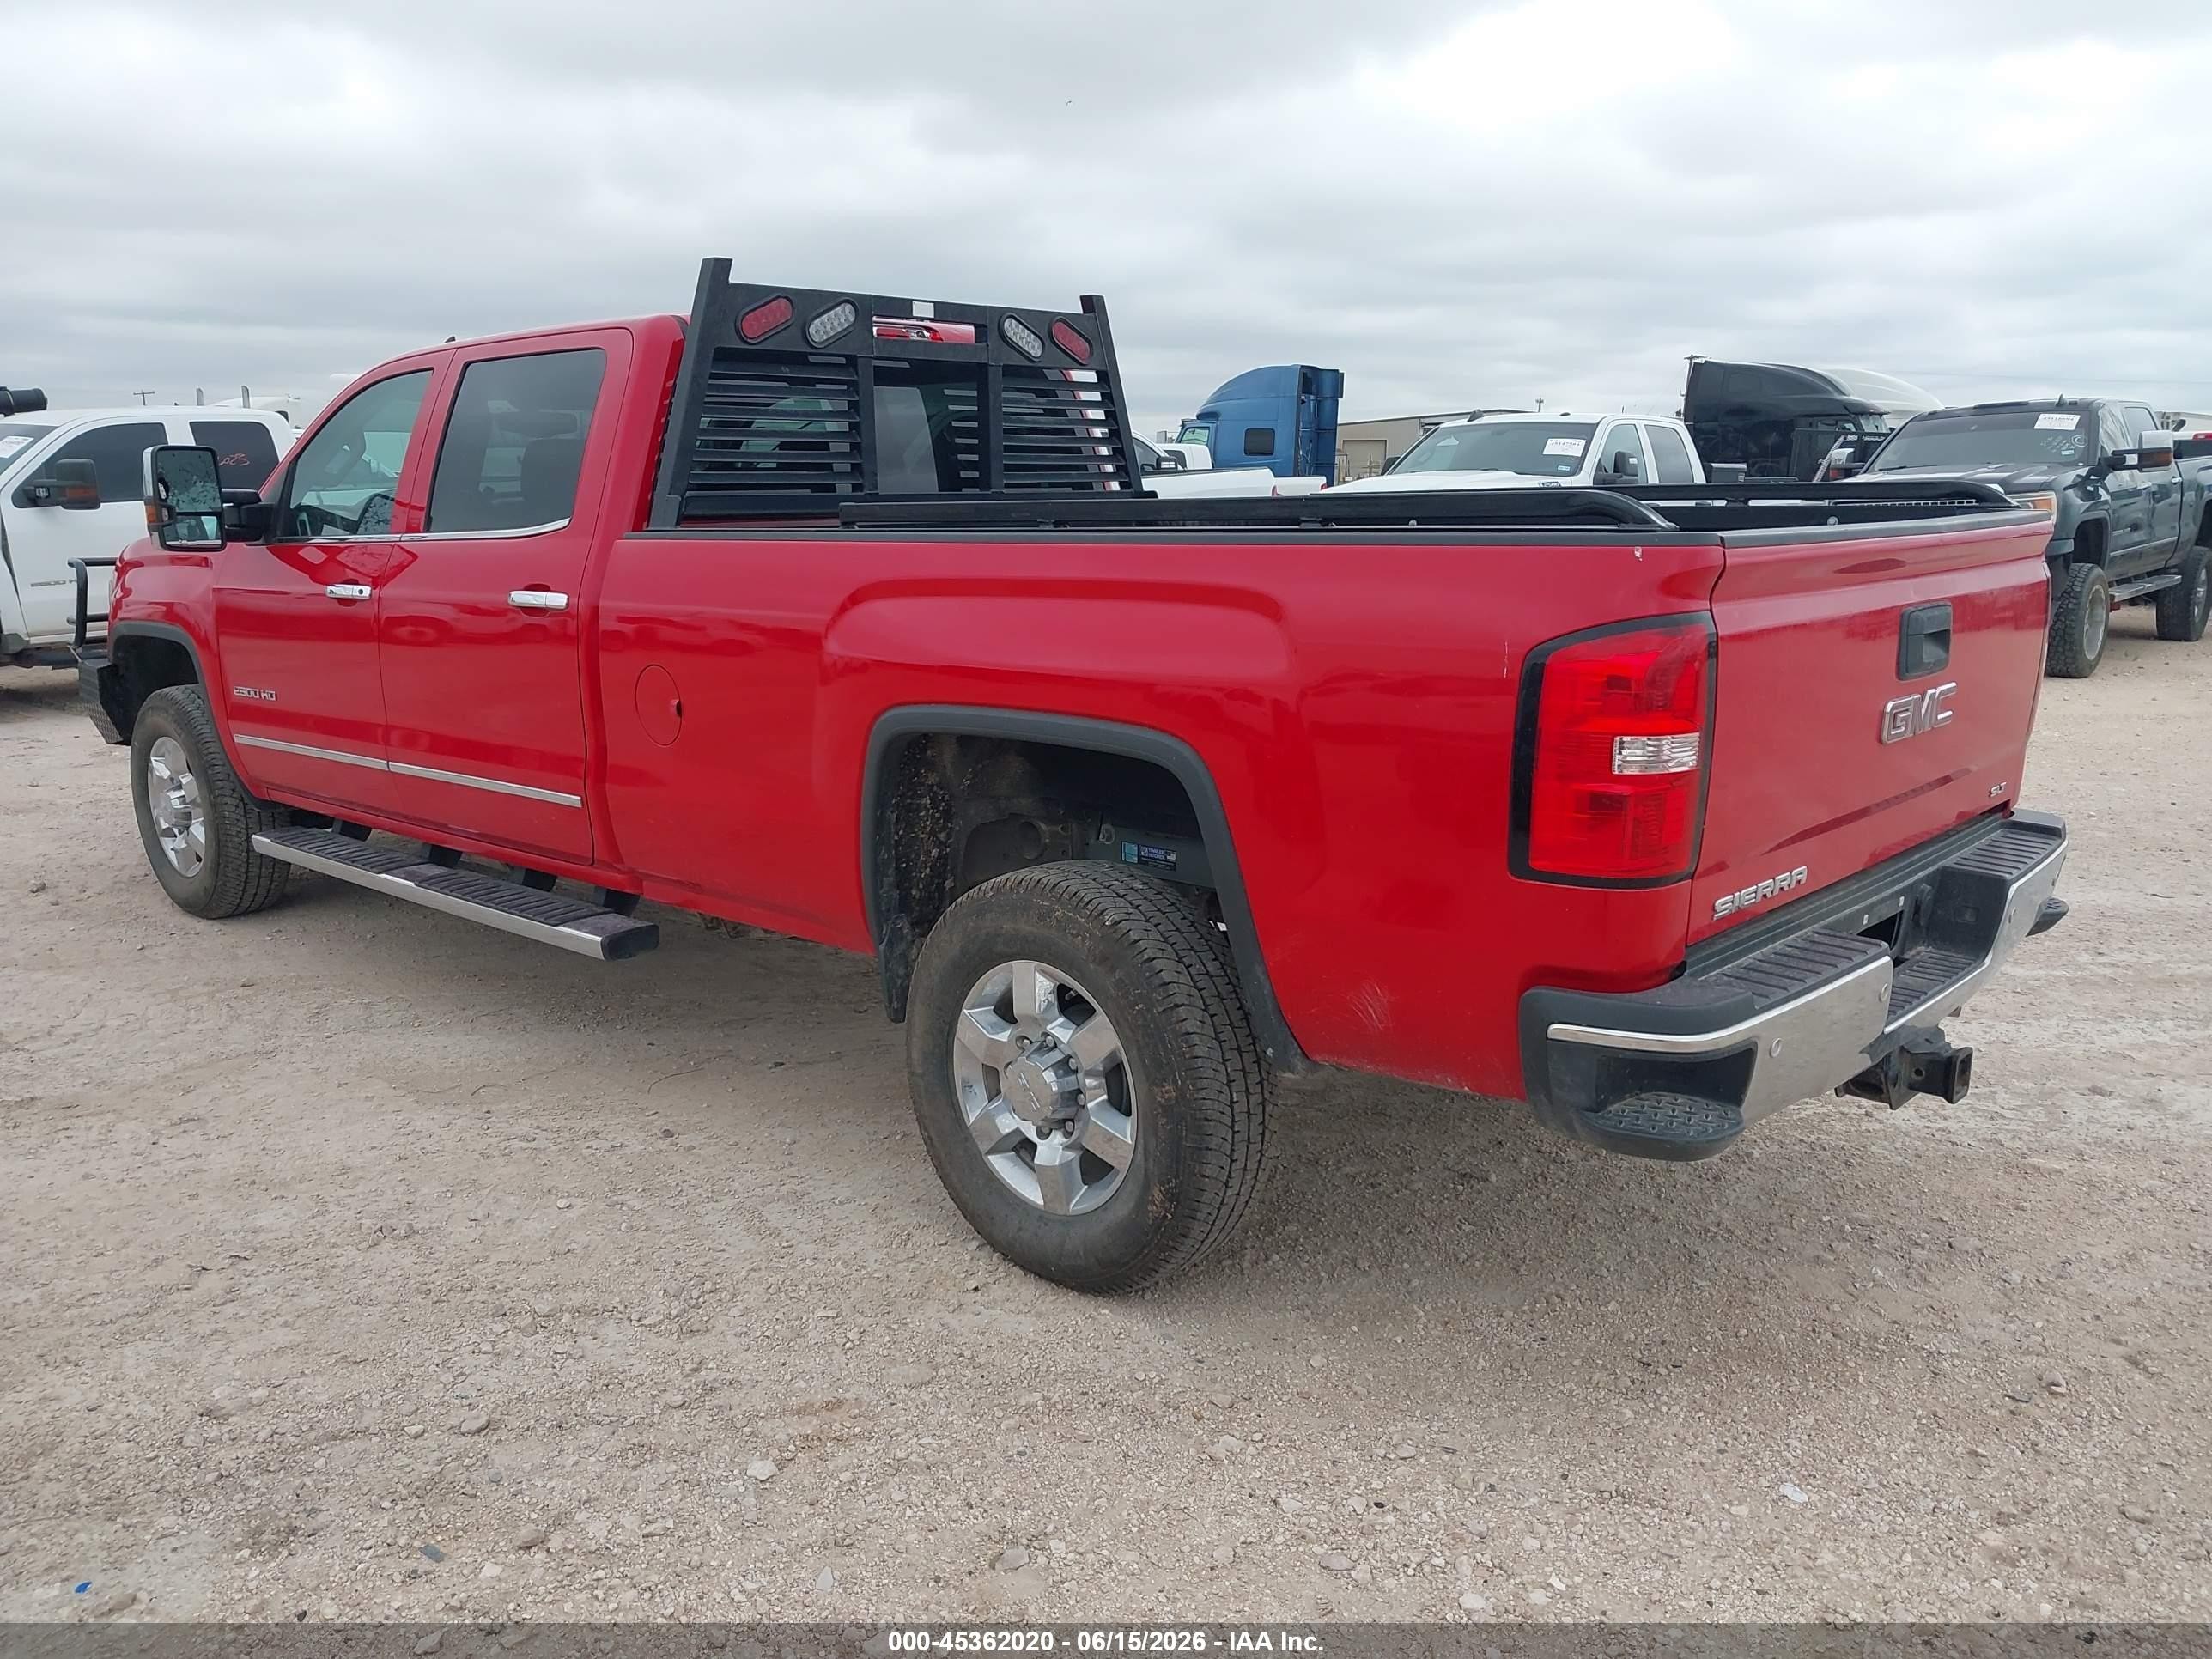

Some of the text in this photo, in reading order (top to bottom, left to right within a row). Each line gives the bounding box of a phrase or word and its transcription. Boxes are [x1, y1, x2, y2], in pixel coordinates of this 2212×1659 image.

[234, 686, 276, 701] 2500 HD
[1881, 682, 1957, 744] GMC
[1989, 781, 2007, 797] SLT
[1713, 866, 1808, 921] SIERRA
